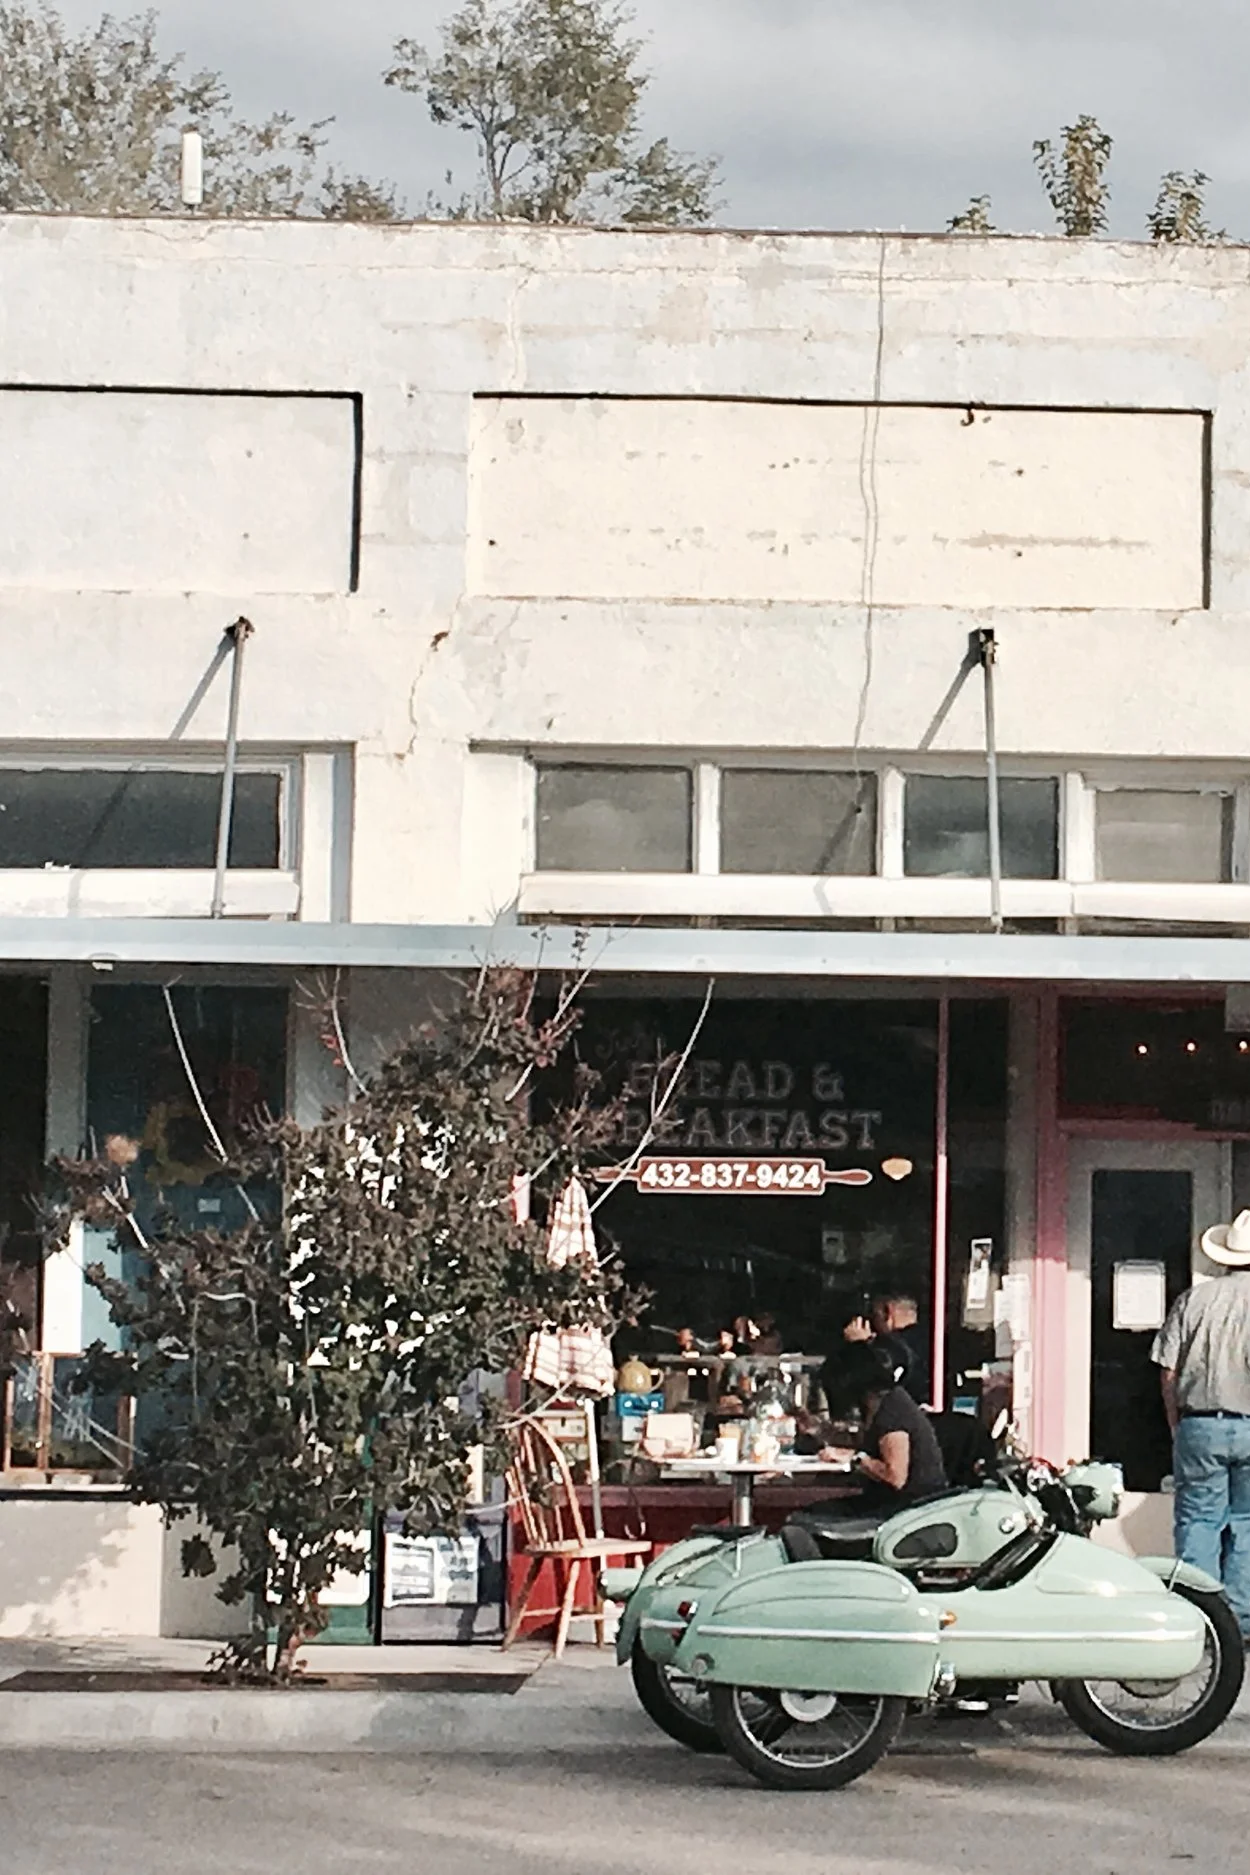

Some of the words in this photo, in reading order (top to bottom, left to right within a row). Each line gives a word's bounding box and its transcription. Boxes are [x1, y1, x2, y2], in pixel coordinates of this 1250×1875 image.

[628, 1060, 795, 1101] BEAD
[812, 1062, 845, 1101] &
[616, 1107, 883, 1150] RAKFAST
[641, 1163, 820, 1188] 432-837-9424
